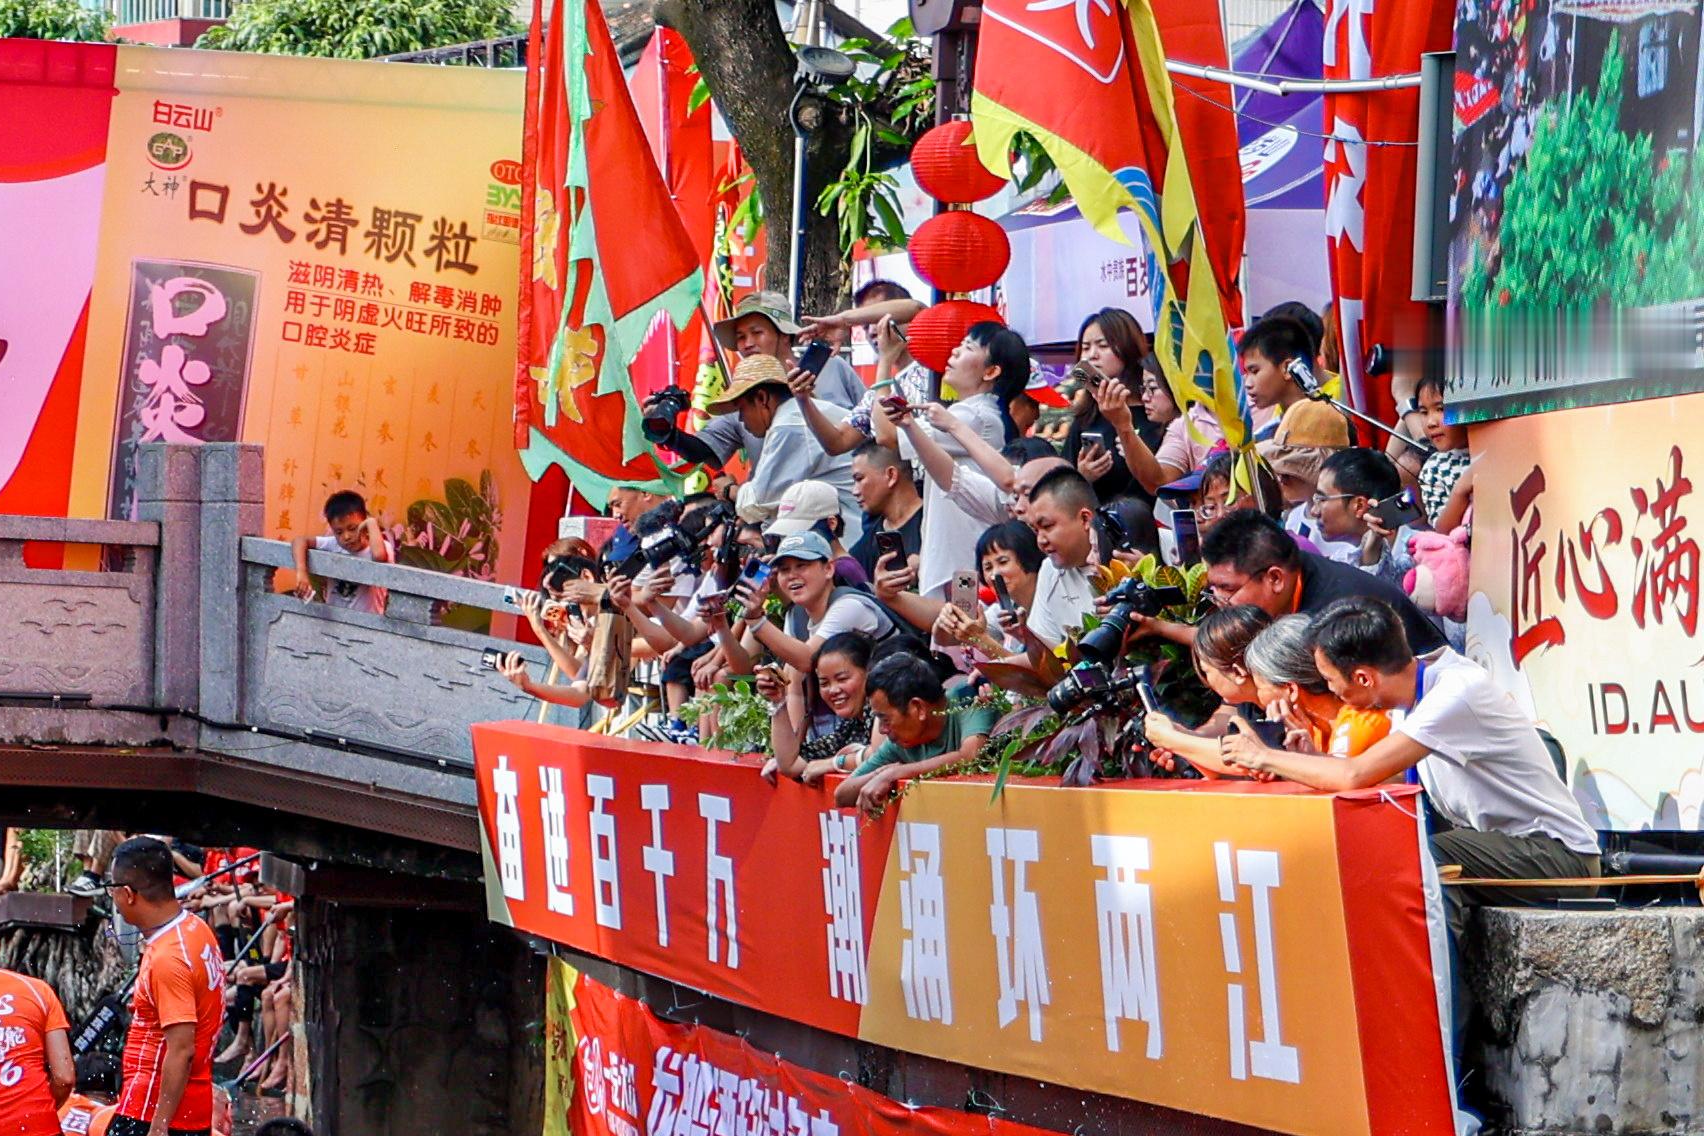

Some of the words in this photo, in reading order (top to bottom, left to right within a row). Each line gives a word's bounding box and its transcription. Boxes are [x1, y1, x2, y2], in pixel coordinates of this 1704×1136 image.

[152, 100, 213, 132] 白云山
[141, 171, 180, 200] 大神
[189, 180, 479, 276] 口炎清颗粒
[284, 290, 500, 346] 用于阴虚火旺所致的
[287, 260, 502, 318] 滋阴清热、解毒消肿
[282, 321, 377, 356] 口腔炎症
[1508, 445, 1701, 671] 匠心满
[492, 755, 739, 970] 奋进百千万
[819, 809, 1300, 1084] 潮涌环两江
